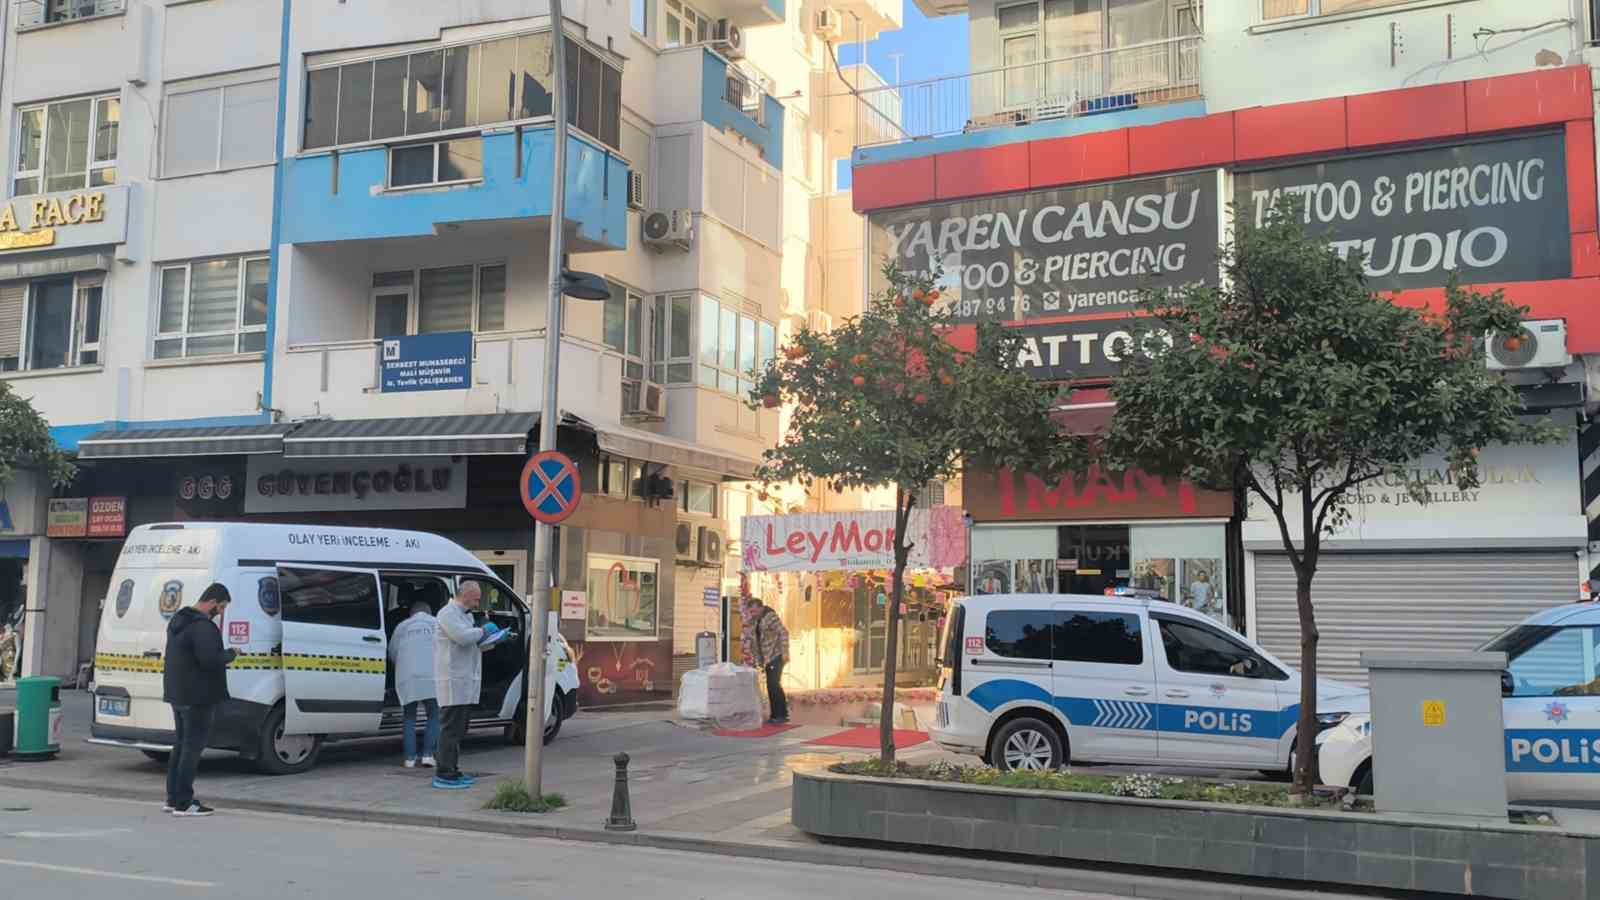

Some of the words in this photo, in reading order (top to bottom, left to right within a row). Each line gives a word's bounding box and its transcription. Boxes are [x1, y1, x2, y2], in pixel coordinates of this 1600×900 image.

[1371, 175, 1396, 217] &
[1405, 158, 1545, 214] PIERCING
[31, 191, 105, 228] FACE
[886, 208, 1027, 257] YAREN
[1032, 189, 1200, 243] CANSU
[1015, 258, 1040, 286] &
[1044, 242, 1186, 283] PIERCING
[257, 464, 453, 500] GÜVENÇOĞLU
[288, 533, 315, 544] OLAY
[231, 624, 247, 635] 112
[967, 638, 982, 648] 112
